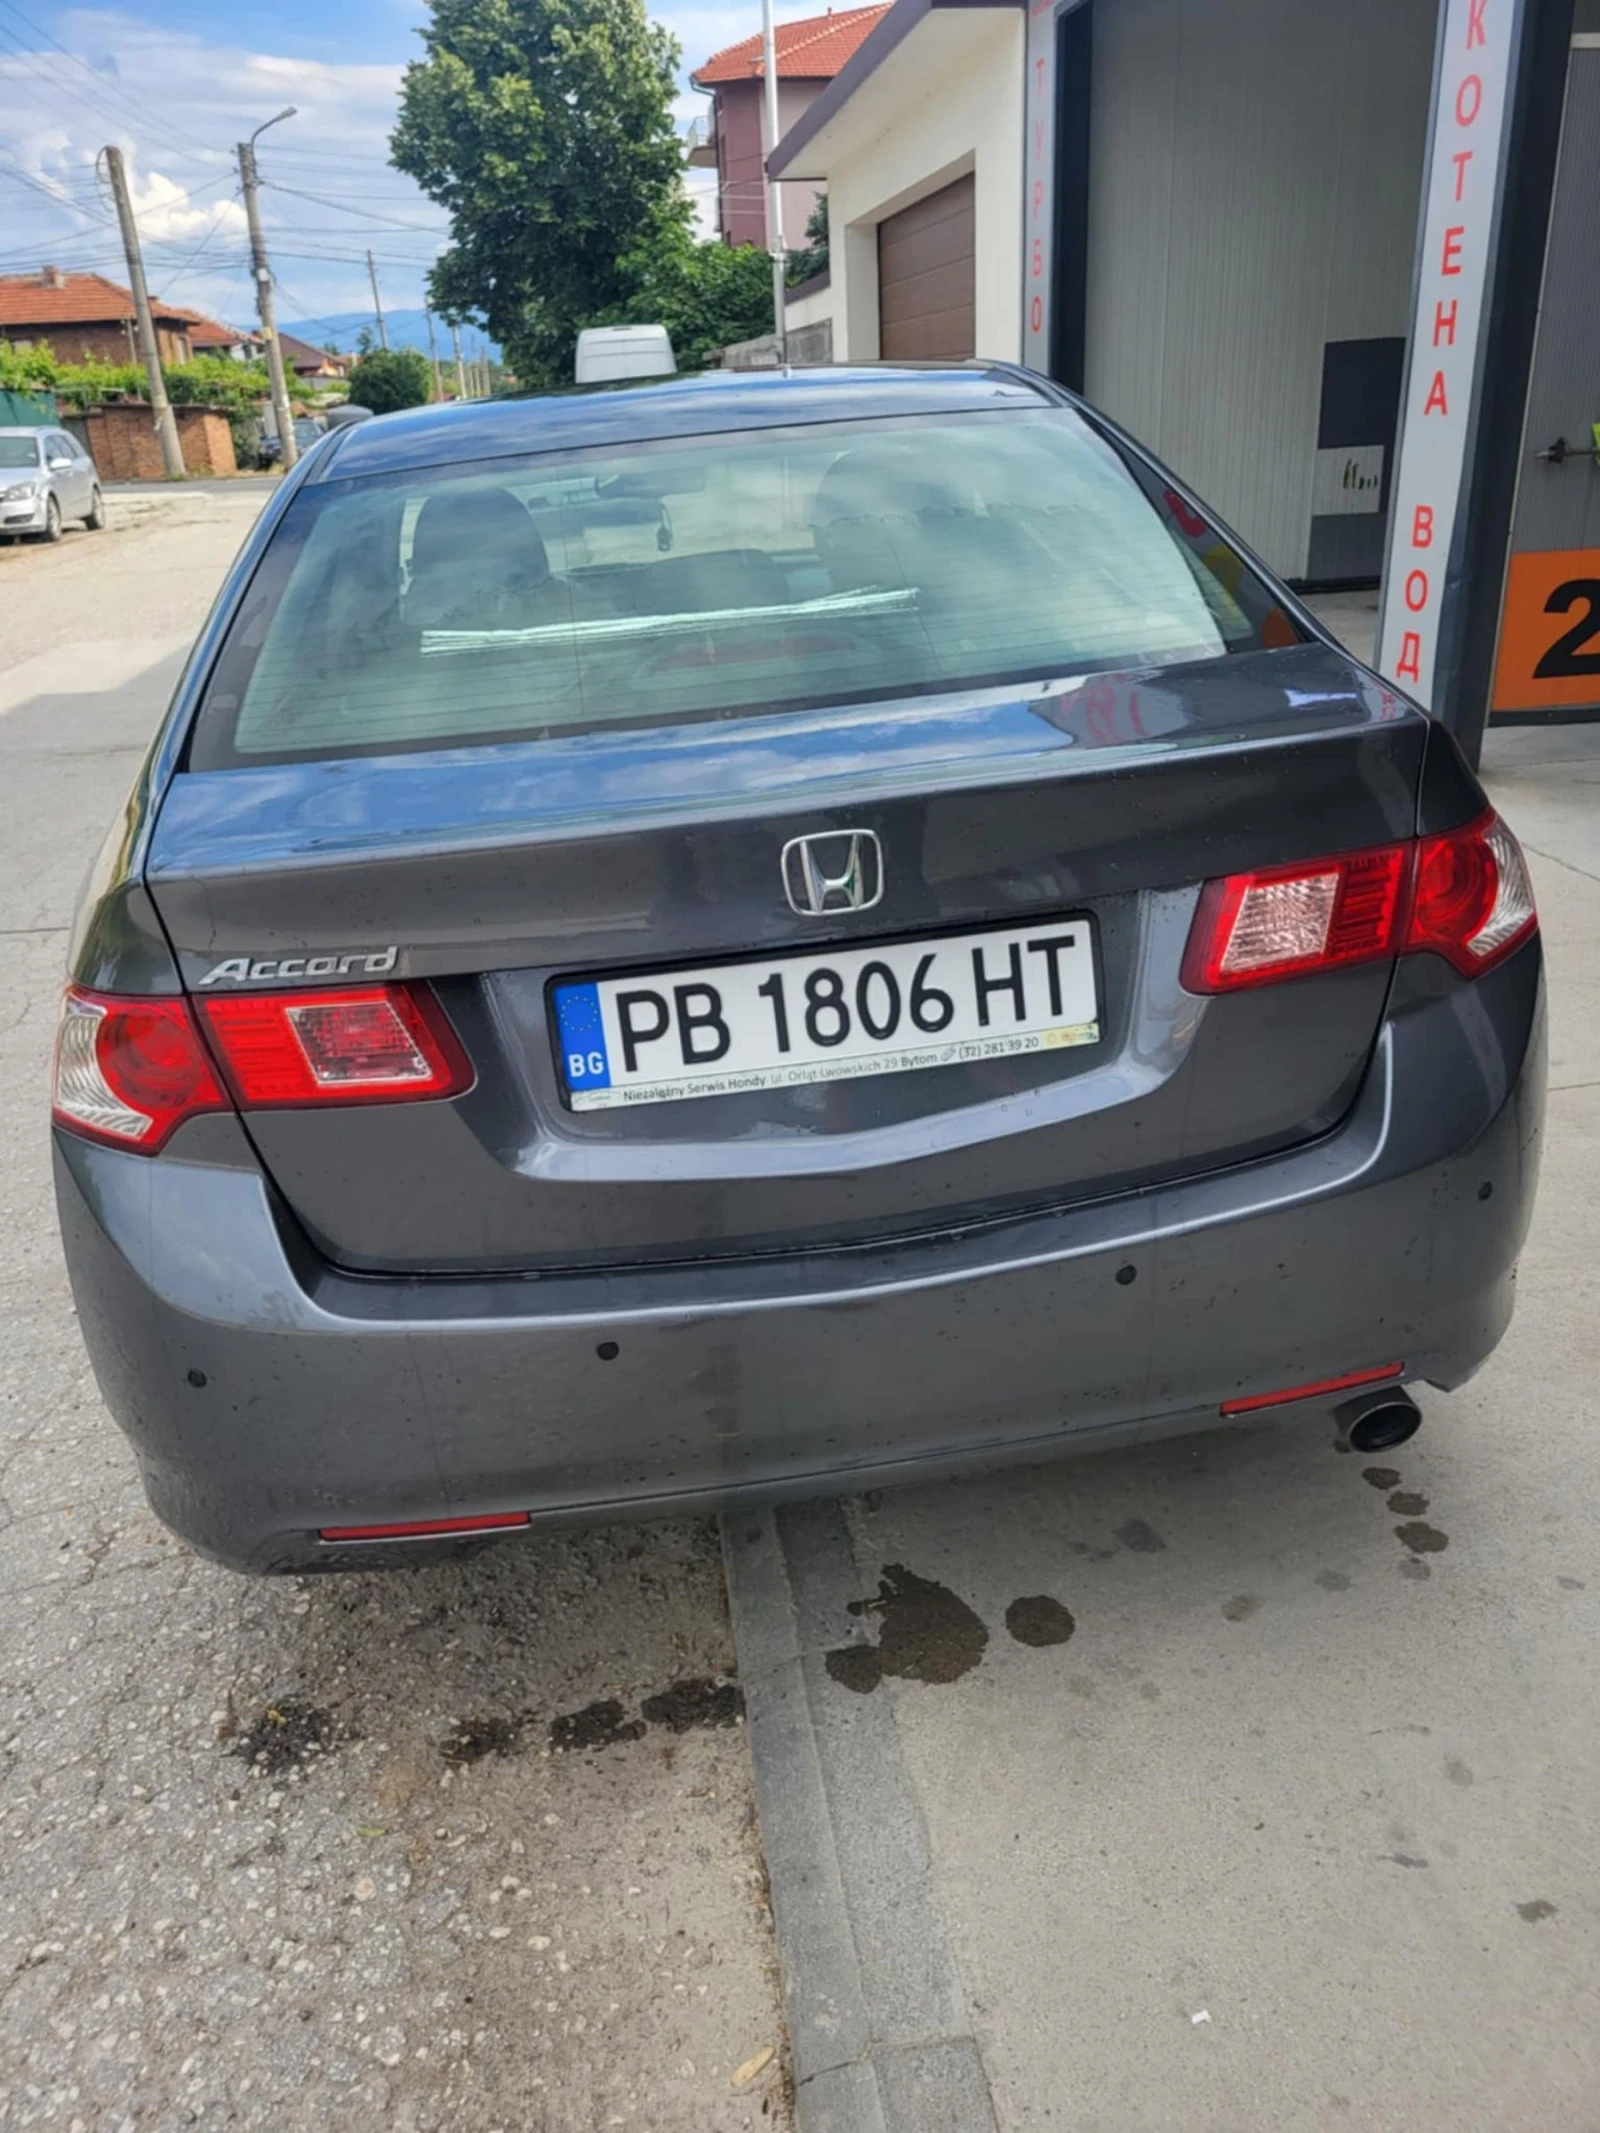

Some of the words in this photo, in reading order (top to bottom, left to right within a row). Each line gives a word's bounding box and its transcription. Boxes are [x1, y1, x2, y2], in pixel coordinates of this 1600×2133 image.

[1532, 578, 1600, 680] 2
[198, 946, 398, 985] Accord
[615, 983, 731, 1073] PB
[758, 953, 955, 1053] 1806
[971, 935, 1076, 1027] HT
[568, 1052, 605, 1078] BG
[687, 1081, 726, 1096] Serwis
[729, 1076, 766, 1091] Hondy
[901, 1054, 938, 1068] Bytom
[958, 1045, 982, 1060] (32)
[984, 1041, 1005, 1056] 281
[1008, 1039, 1022, 1051] 39
[1024, 1037, 1039, 1049] 20
